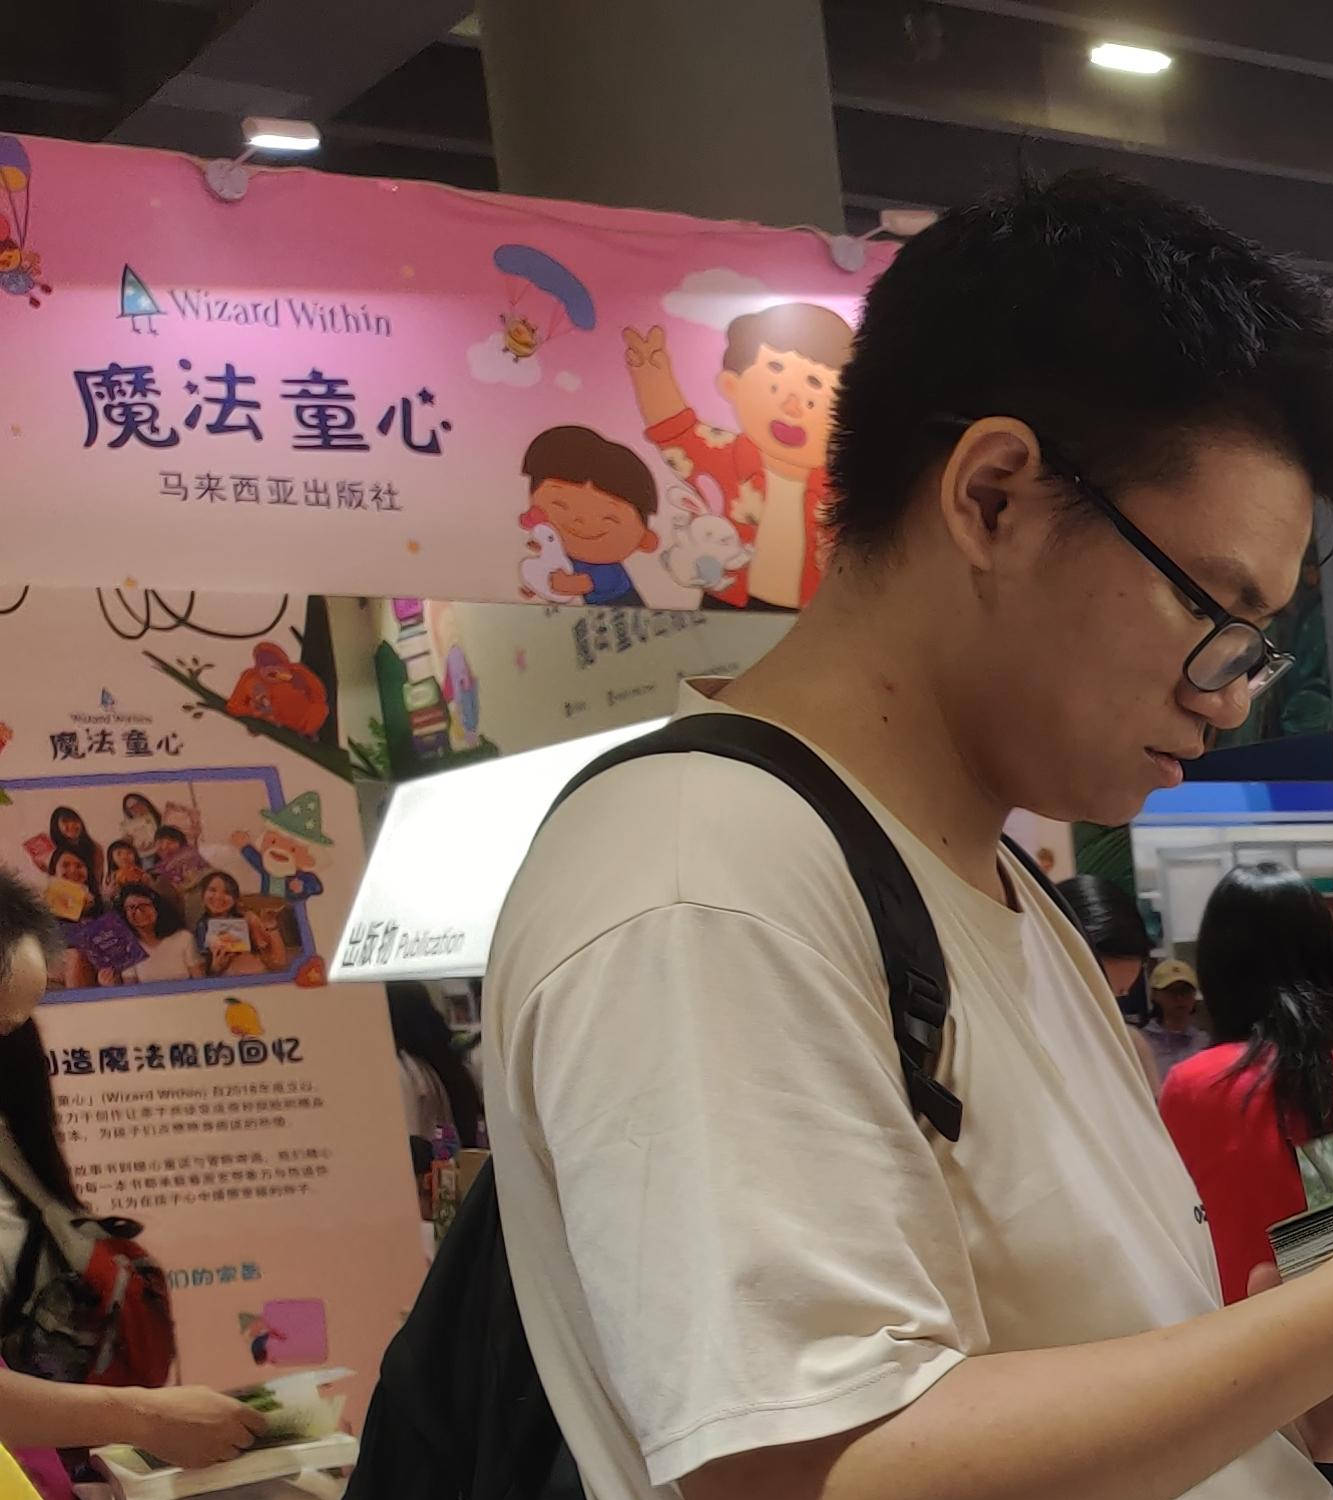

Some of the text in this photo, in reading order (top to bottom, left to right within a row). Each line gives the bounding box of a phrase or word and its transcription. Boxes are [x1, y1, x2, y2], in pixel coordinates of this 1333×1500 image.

[168, 287, 392, 337] Wizard Within
[73, 358, 453, 455] 魔法童心
[159, 470, 404, 512] 马来西亚出版社
[49, 729, 185, 761] 魔法童心
[341, 919, 465, 968] 出版物 Publication
